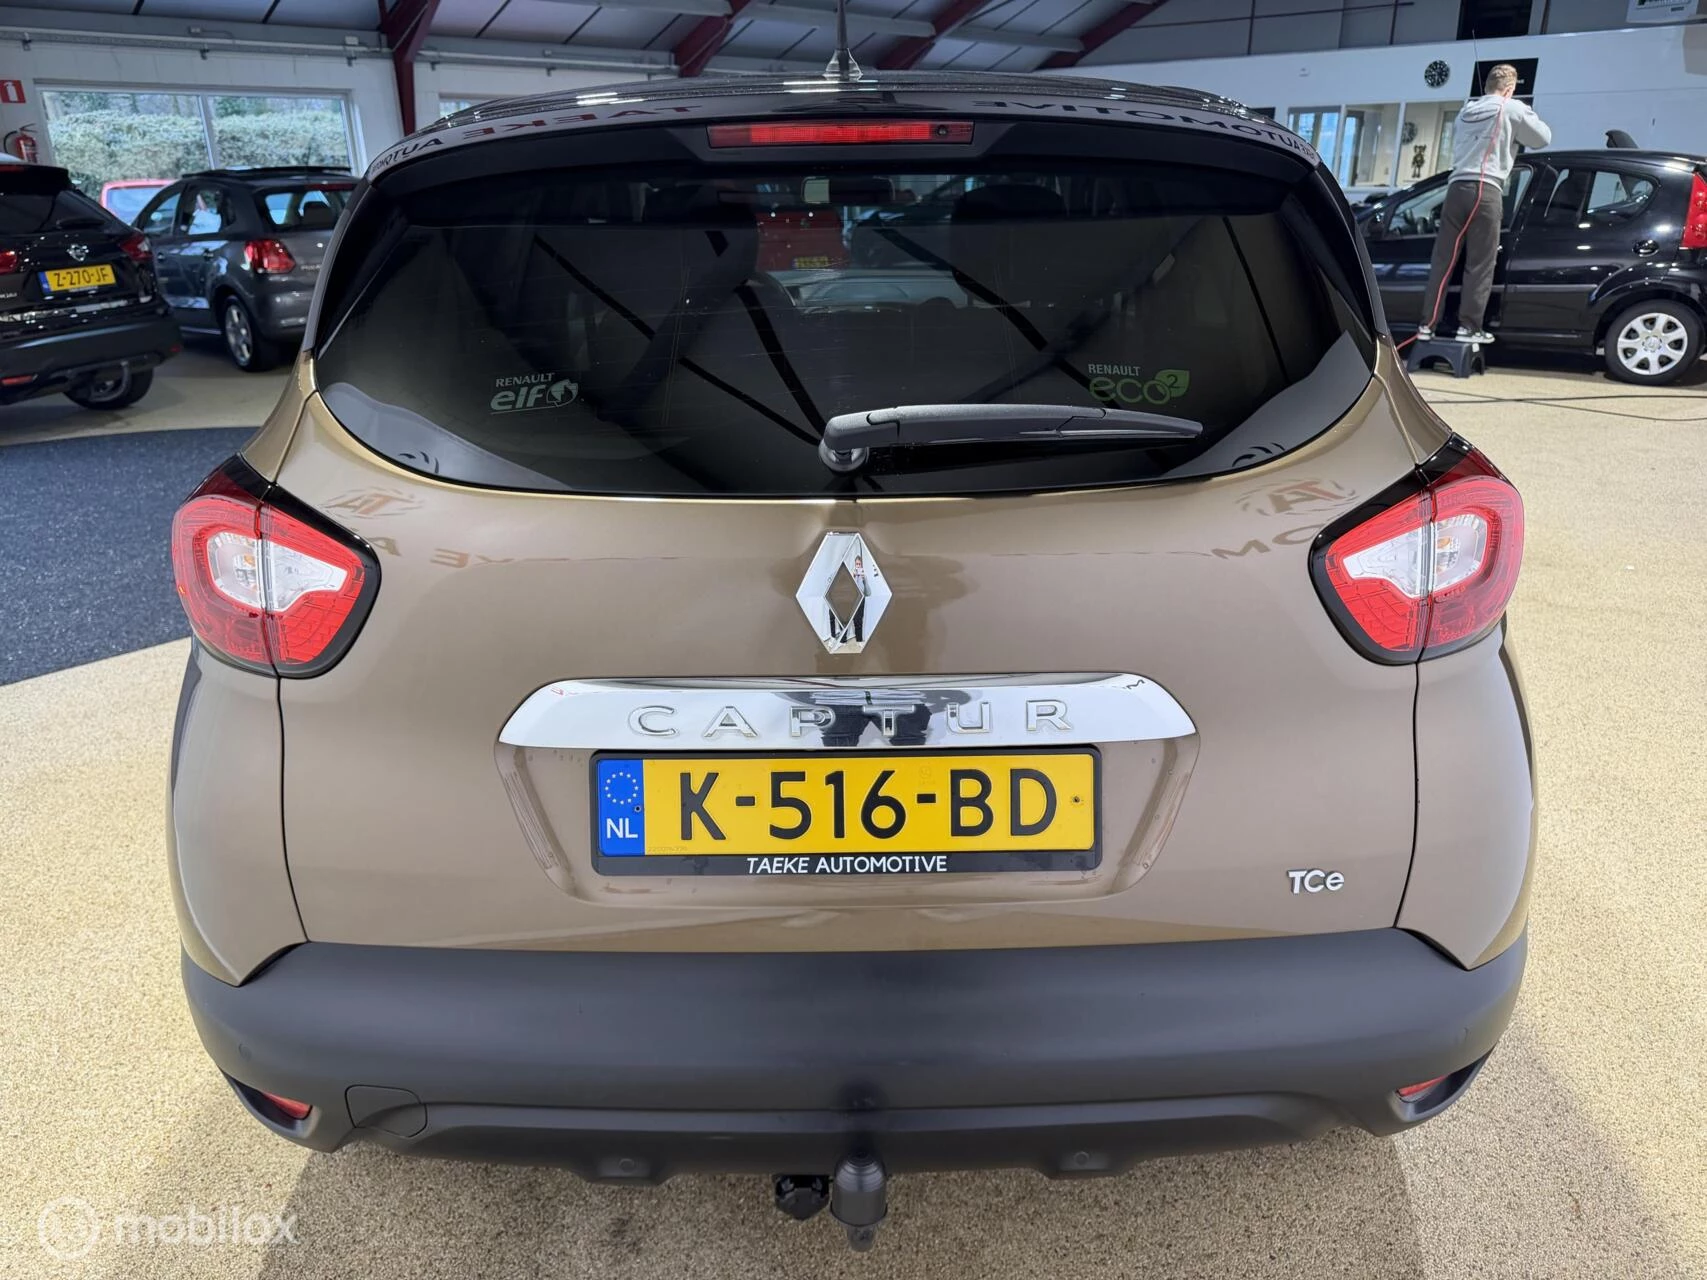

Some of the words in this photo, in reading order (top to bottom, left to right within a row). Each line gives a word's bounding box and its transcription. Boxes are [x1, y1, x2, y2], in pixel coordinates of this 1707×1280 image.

[54, 267, 109, 287] Z-270-JF
[495, 372, 555, 388] RENAULT
[1088, 364, 1140, 376] RENAULT
[490, 384, 546, 411] elf
[627, 699, 1073, 738] CAPTUR
[680, 767, 1058, 841] K-516-BD
[606, 817, 638, 838] NL
[745, 857, 809, 874] TAEKE
[816, 856, 947, 874] AUTOMOTIVE
[1286, 868, 1345, 894] TCe
